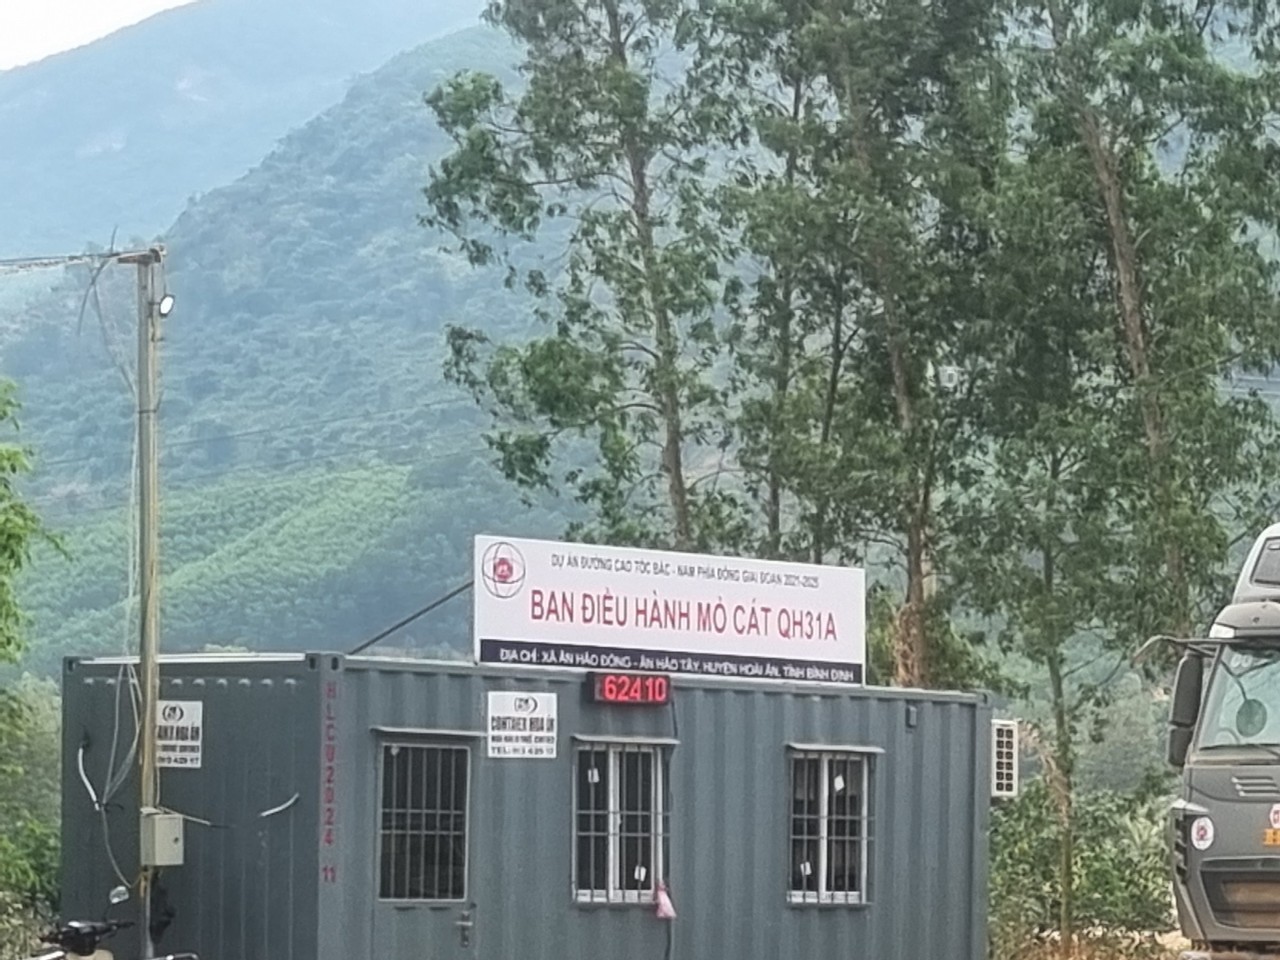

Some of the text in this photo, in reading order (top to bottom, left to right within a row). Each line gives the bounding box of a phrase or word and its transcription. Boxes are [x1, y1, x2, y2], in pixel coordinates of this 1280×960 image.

[614, 558, 632, 573] CAO
[531, 587, 837, 641] BAN ĐIỀU HÀNH MỎ CÁT QH31A
[604, 674, 668, 702] 62410
